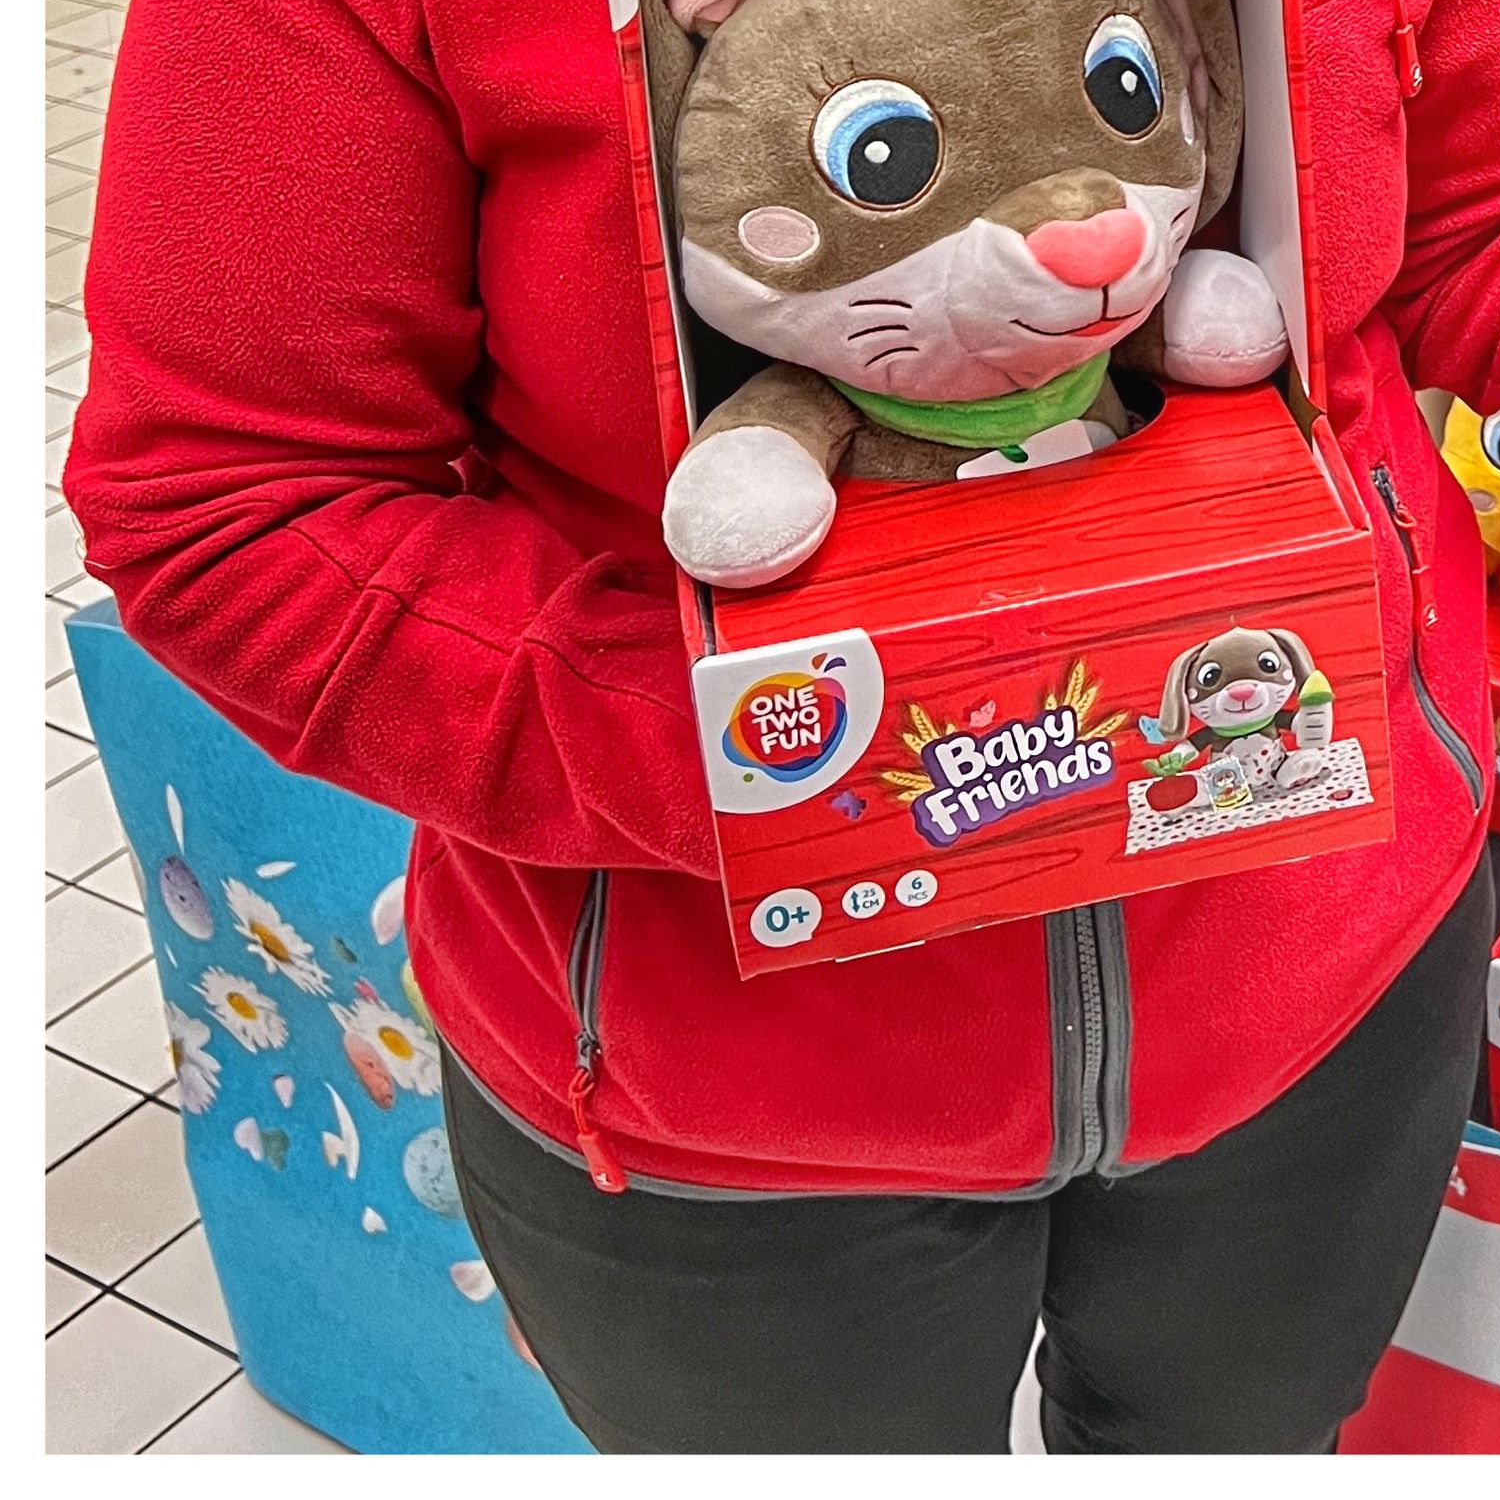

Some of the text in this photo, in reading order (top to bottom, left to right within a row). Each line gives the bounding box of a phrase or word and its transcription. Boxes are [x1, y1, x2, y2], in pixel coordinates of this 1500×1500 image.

[749, 685, 818, 716] ONE
[751, 705, 821, 734] TWO
[760, 723, 822, 755] FUN
[934, 710, 1074, 788] Baby
[924, 740, 1112, 836] Friends
[862, 887, 877, 899] 25
[907, 891, 929, 903] PCS
[911, 876, 922, 890] 6
[861, 898, 880, 910] CM
[765, 905, 810, 933] 0+
